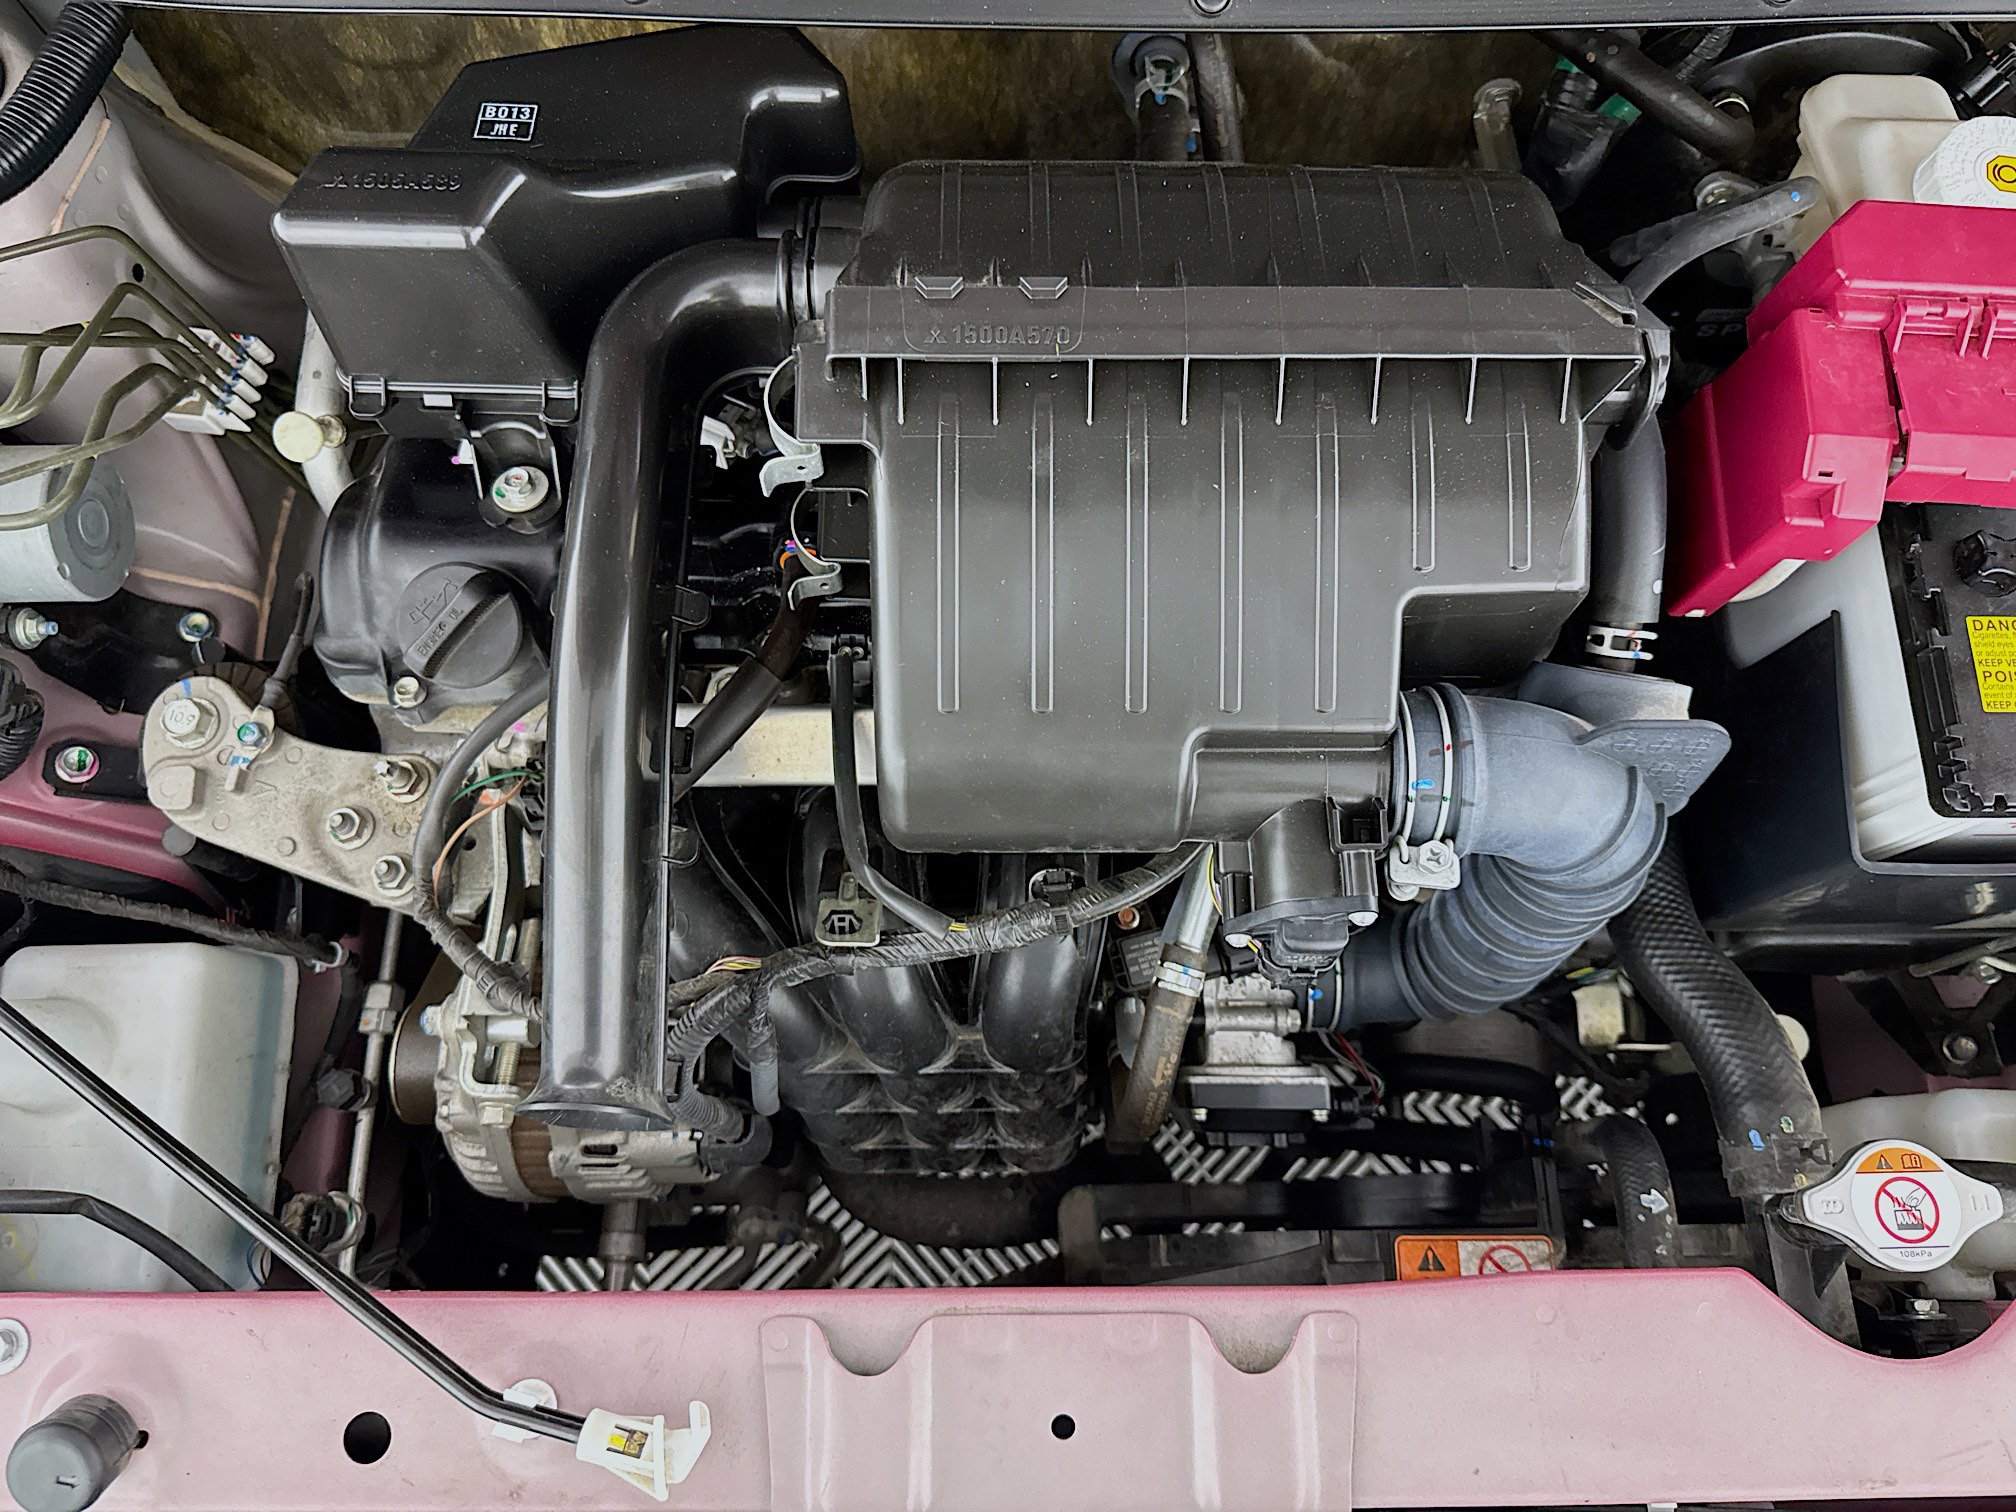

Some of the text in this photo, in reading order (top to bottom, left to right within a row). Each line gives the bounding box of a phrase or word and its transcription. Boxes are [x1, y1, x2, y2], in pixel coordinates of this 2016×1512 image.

[484, 105, 531, 120] B013
[489, 123, 518, 136] JHE
[952, 324, 1070, 345] 1500A570
[1985, 650, 2007, 658] adjust
[1978, 659, 2003, 667] KEEP
[1986, 701, 2011, 709] KEEP
[169, 709, 196, 721] 10.9
[1899, 1250, 1933, 1258] 108kPa
